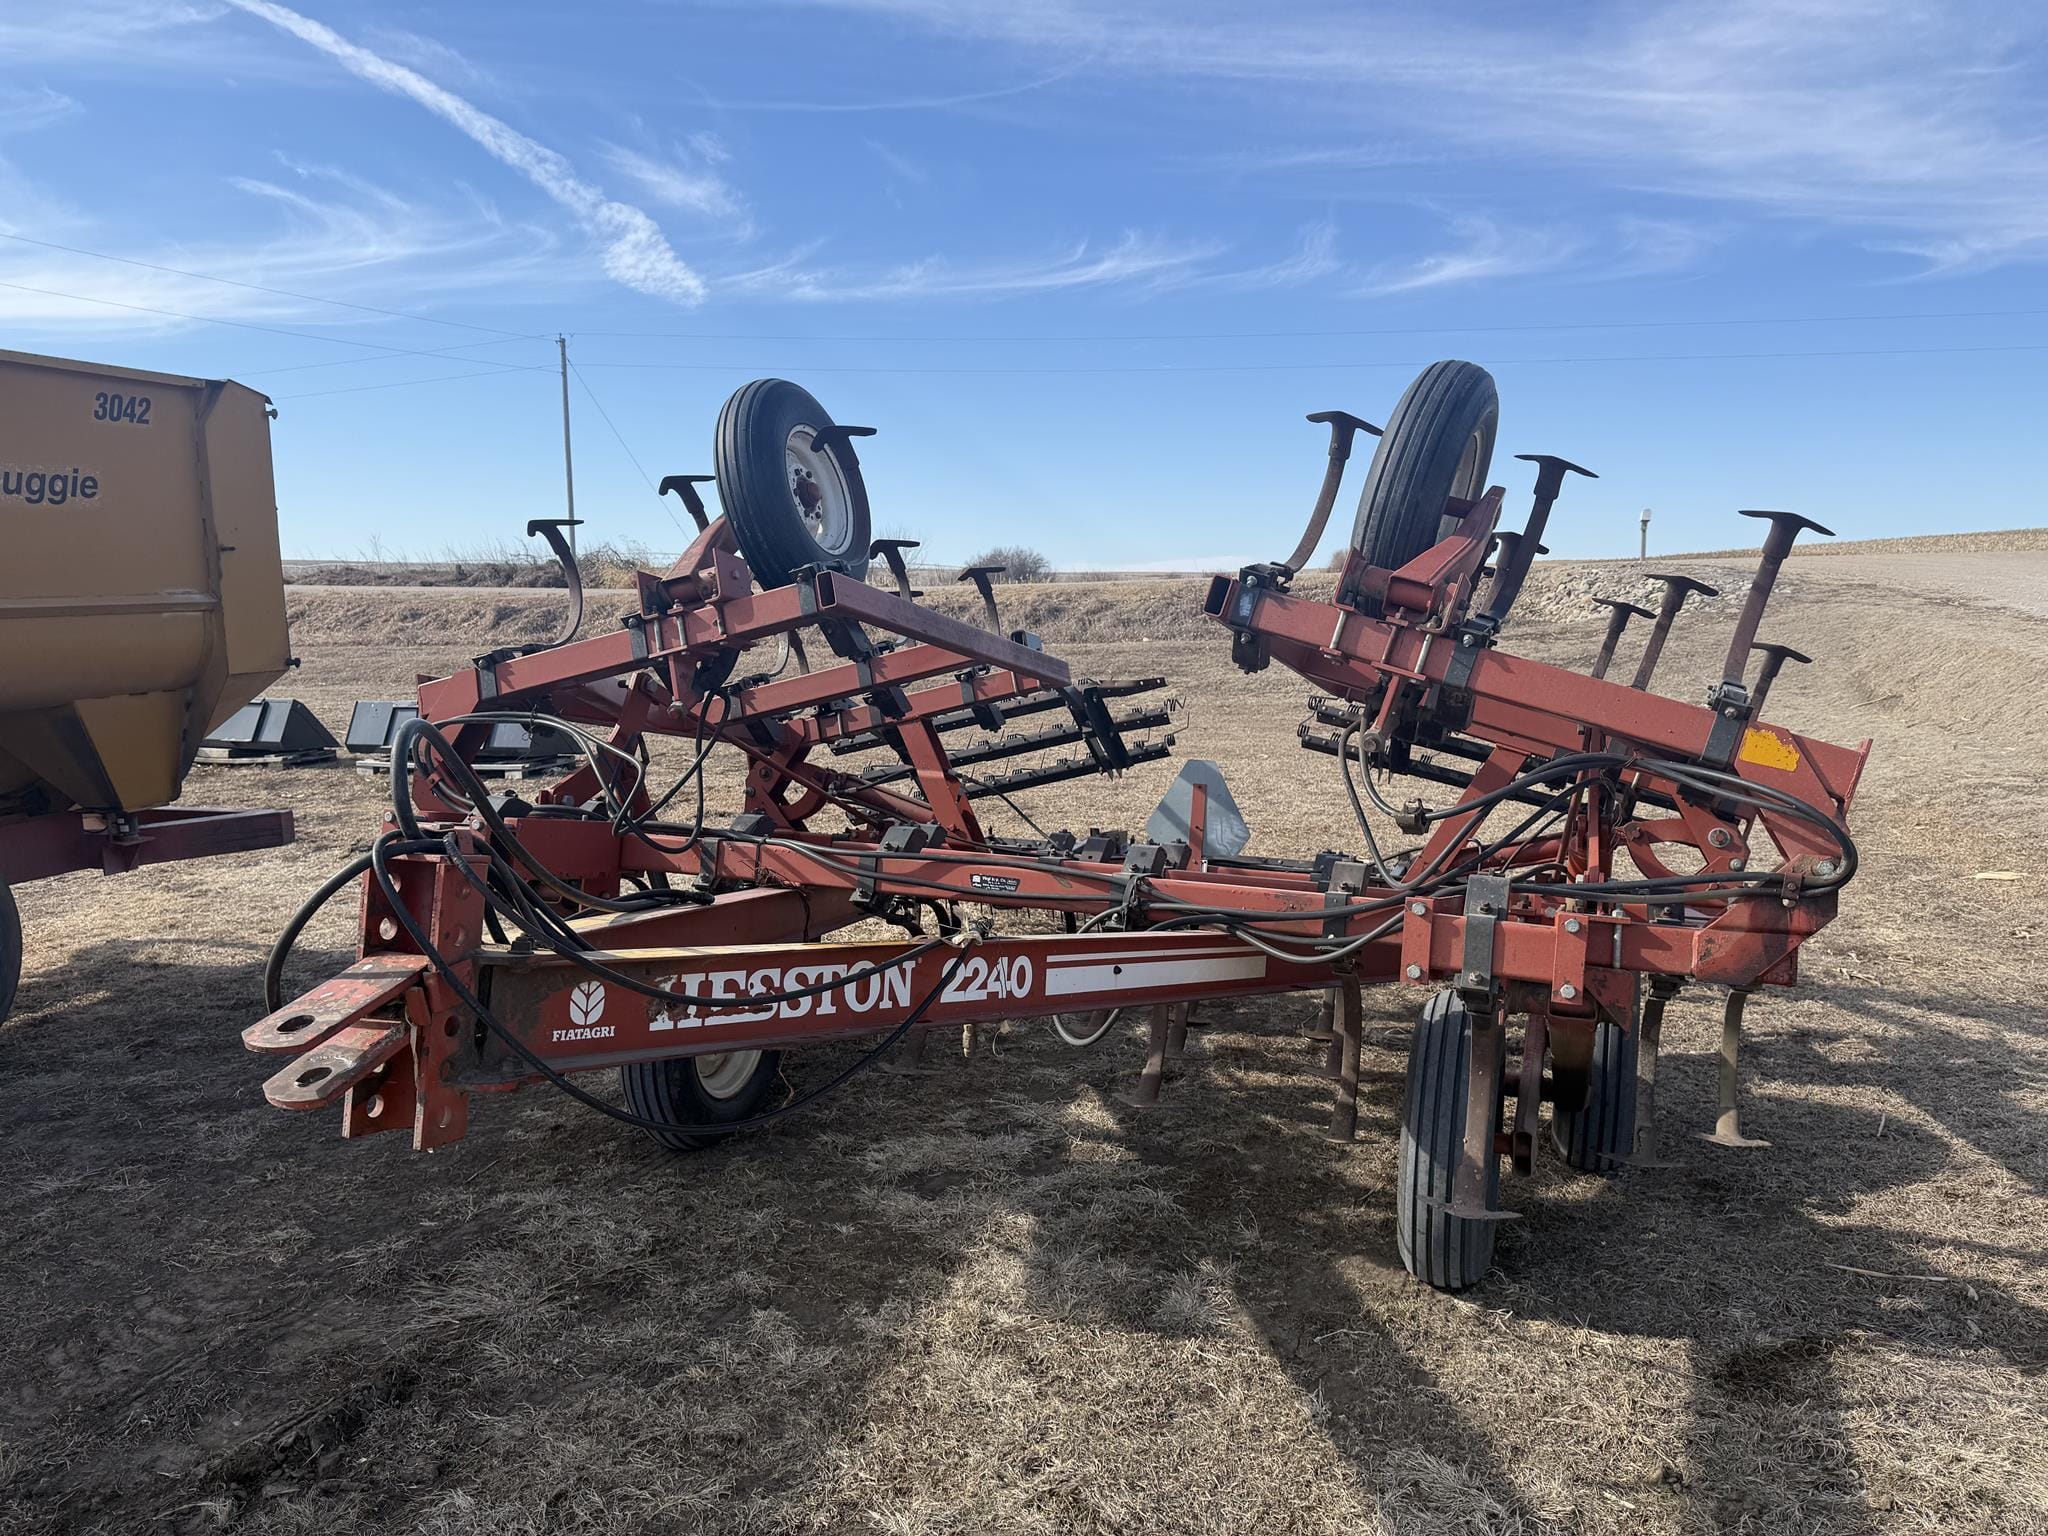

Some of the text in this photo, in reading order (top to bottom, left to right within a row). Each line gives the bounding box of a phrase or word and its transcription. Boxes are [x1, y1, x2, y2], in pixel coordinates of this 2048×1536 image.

[93, 392, 151, 424] 3042
[0, 468, 98, 504] uggie
[940, 955, 1033, 1003] 2240
[552, 1026, 616, 1042] FIATAGRI
